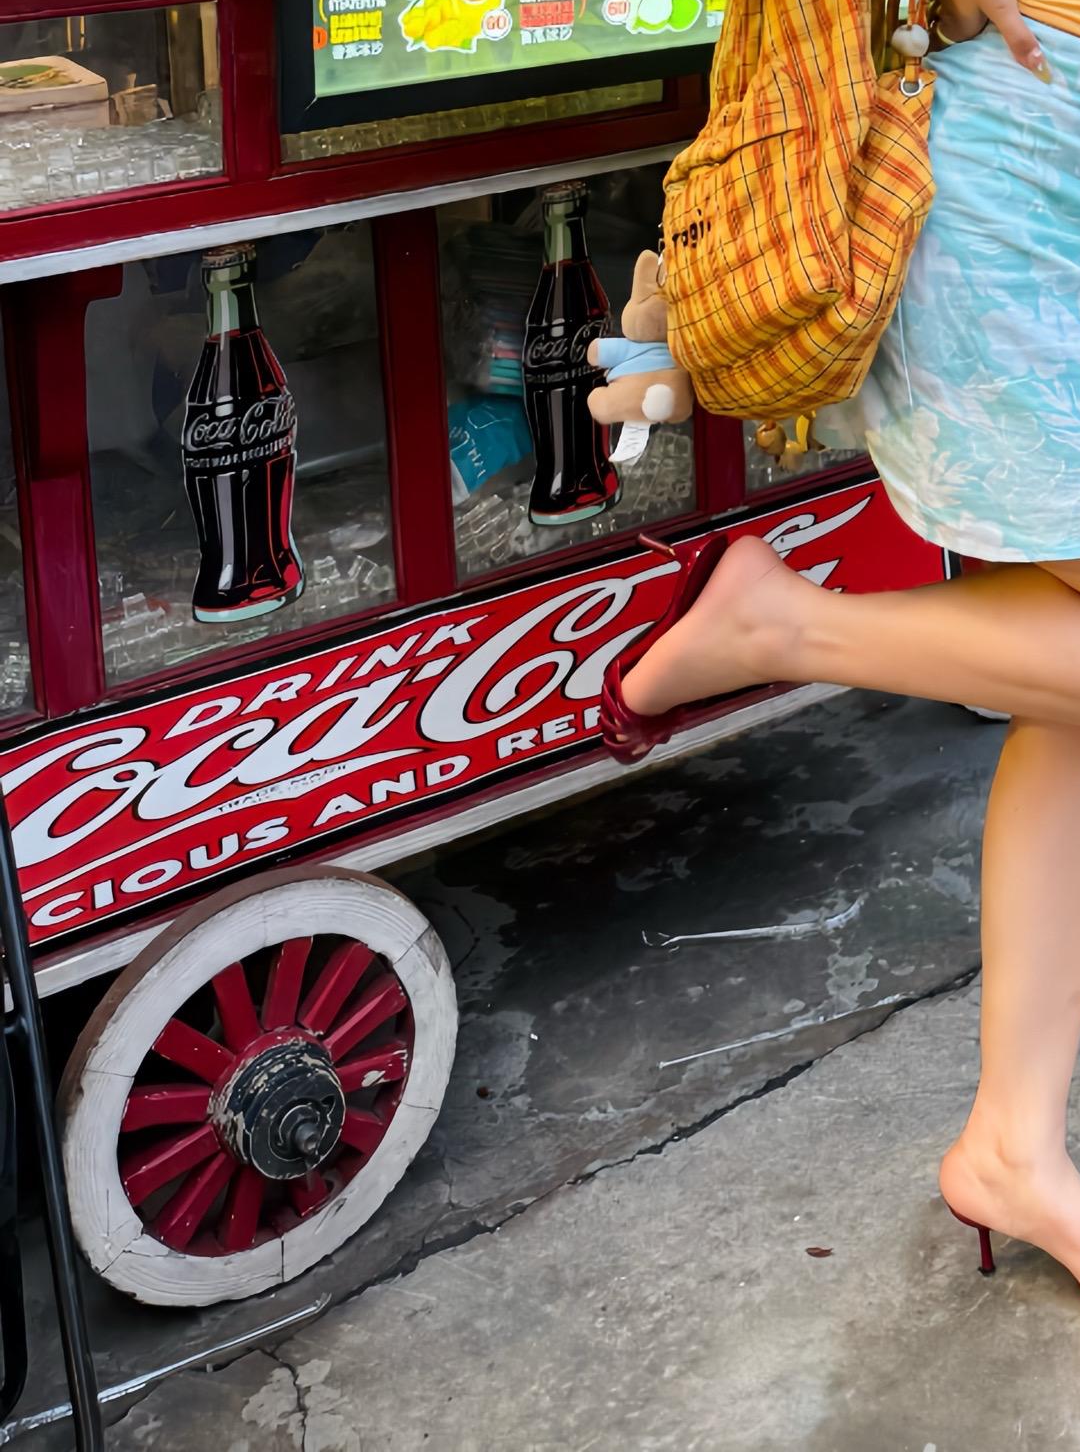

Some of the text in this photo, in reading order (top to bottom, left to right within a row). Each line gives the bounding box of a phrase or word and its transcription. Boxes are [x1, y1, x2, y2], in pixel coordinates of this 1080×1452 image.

[485, 15, 508, 30] 60
[163, 613, 492, 740] DRINK
[315, 754, 471, 830] AND
